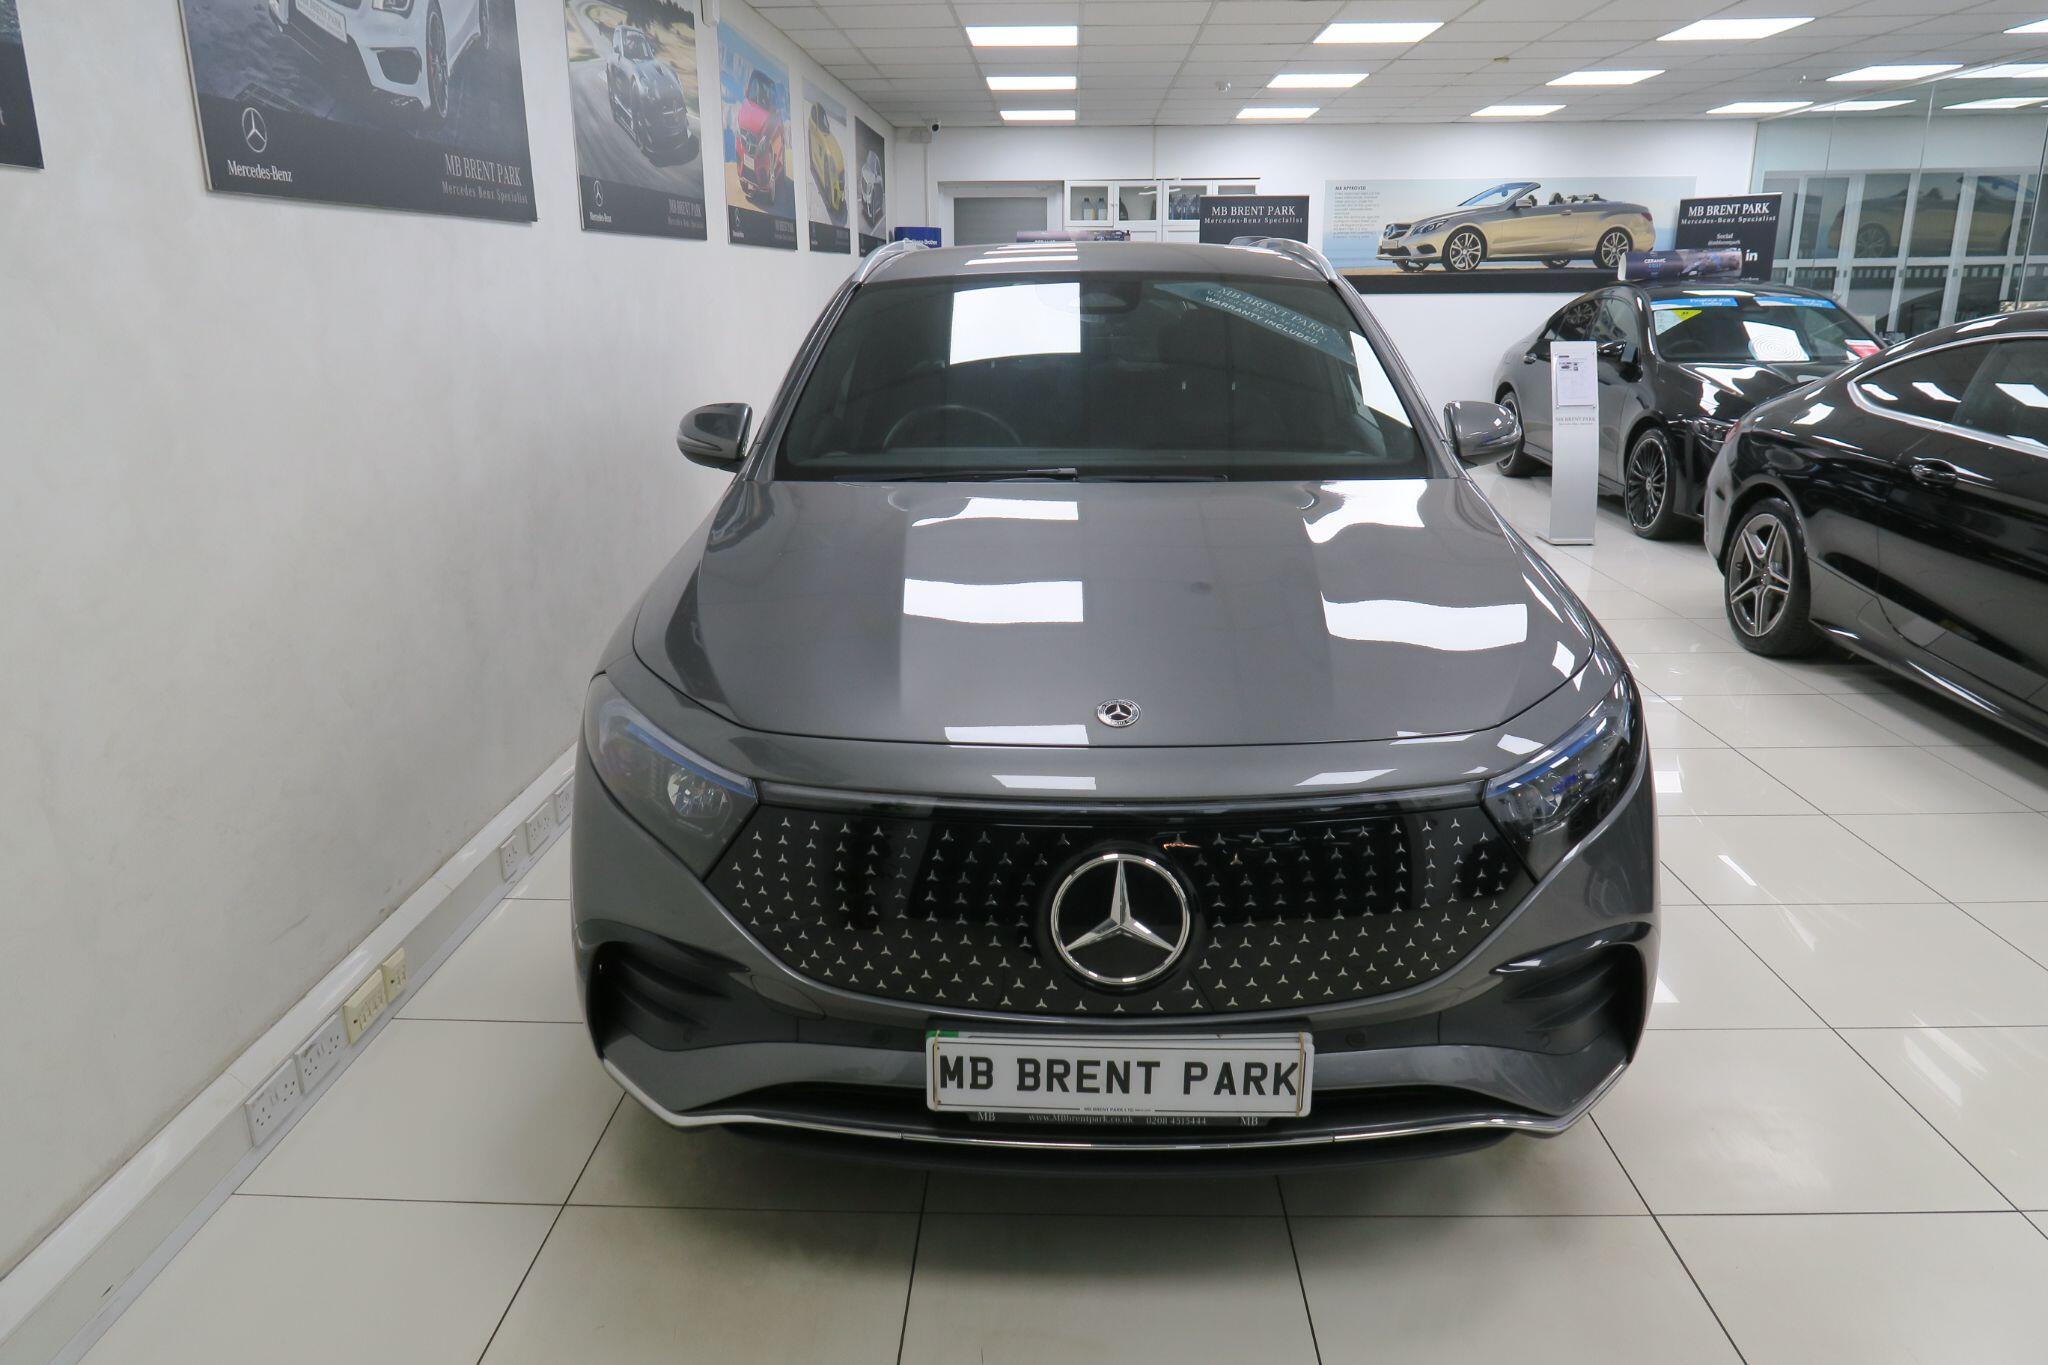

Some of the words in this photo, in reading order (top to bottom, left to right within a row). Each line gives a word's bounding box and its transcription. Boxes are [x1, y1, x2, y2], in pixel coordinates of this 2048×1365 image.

[227, 159, 293, 183] Mercedes-Benz
[445, 153, 462, 177] MB
[463, 157, 495, 182] BRENT
[496, 163, 522, 187] PARK
[1212, 206, 1228, 216] MB
[1231, 206, 1264, 216] BRENT
[1267, 206, 1296, 216] PARK
[1688, 207, 1704, 217] MB
[1706, 204, 1741, 216] BRENT
[1742, 203, 1770, 214] PARK
[1264, 217, 1303, 225] Specialist
[1738, 215, 1776, 223] Specialist
[1745, 249, 1758, 261] in
[1217, 287, 1241, 299] MB
[1242, 296, 1289, 317] BRENT
[1291, 314, 1326, 334] PARK
[1205, 296, 1264, 320] WARRANTY
[1264, 319, 1319, 344] INCLUDED
[939, 1055, 994, 1090] MB
[1016, 1057, 1161, 1095] BRENT
[1183, 1061, 1299, 1097] PARK
[977, 1111, 996, 1122] MB
[1240, 1116, 1259, 1127] MB
